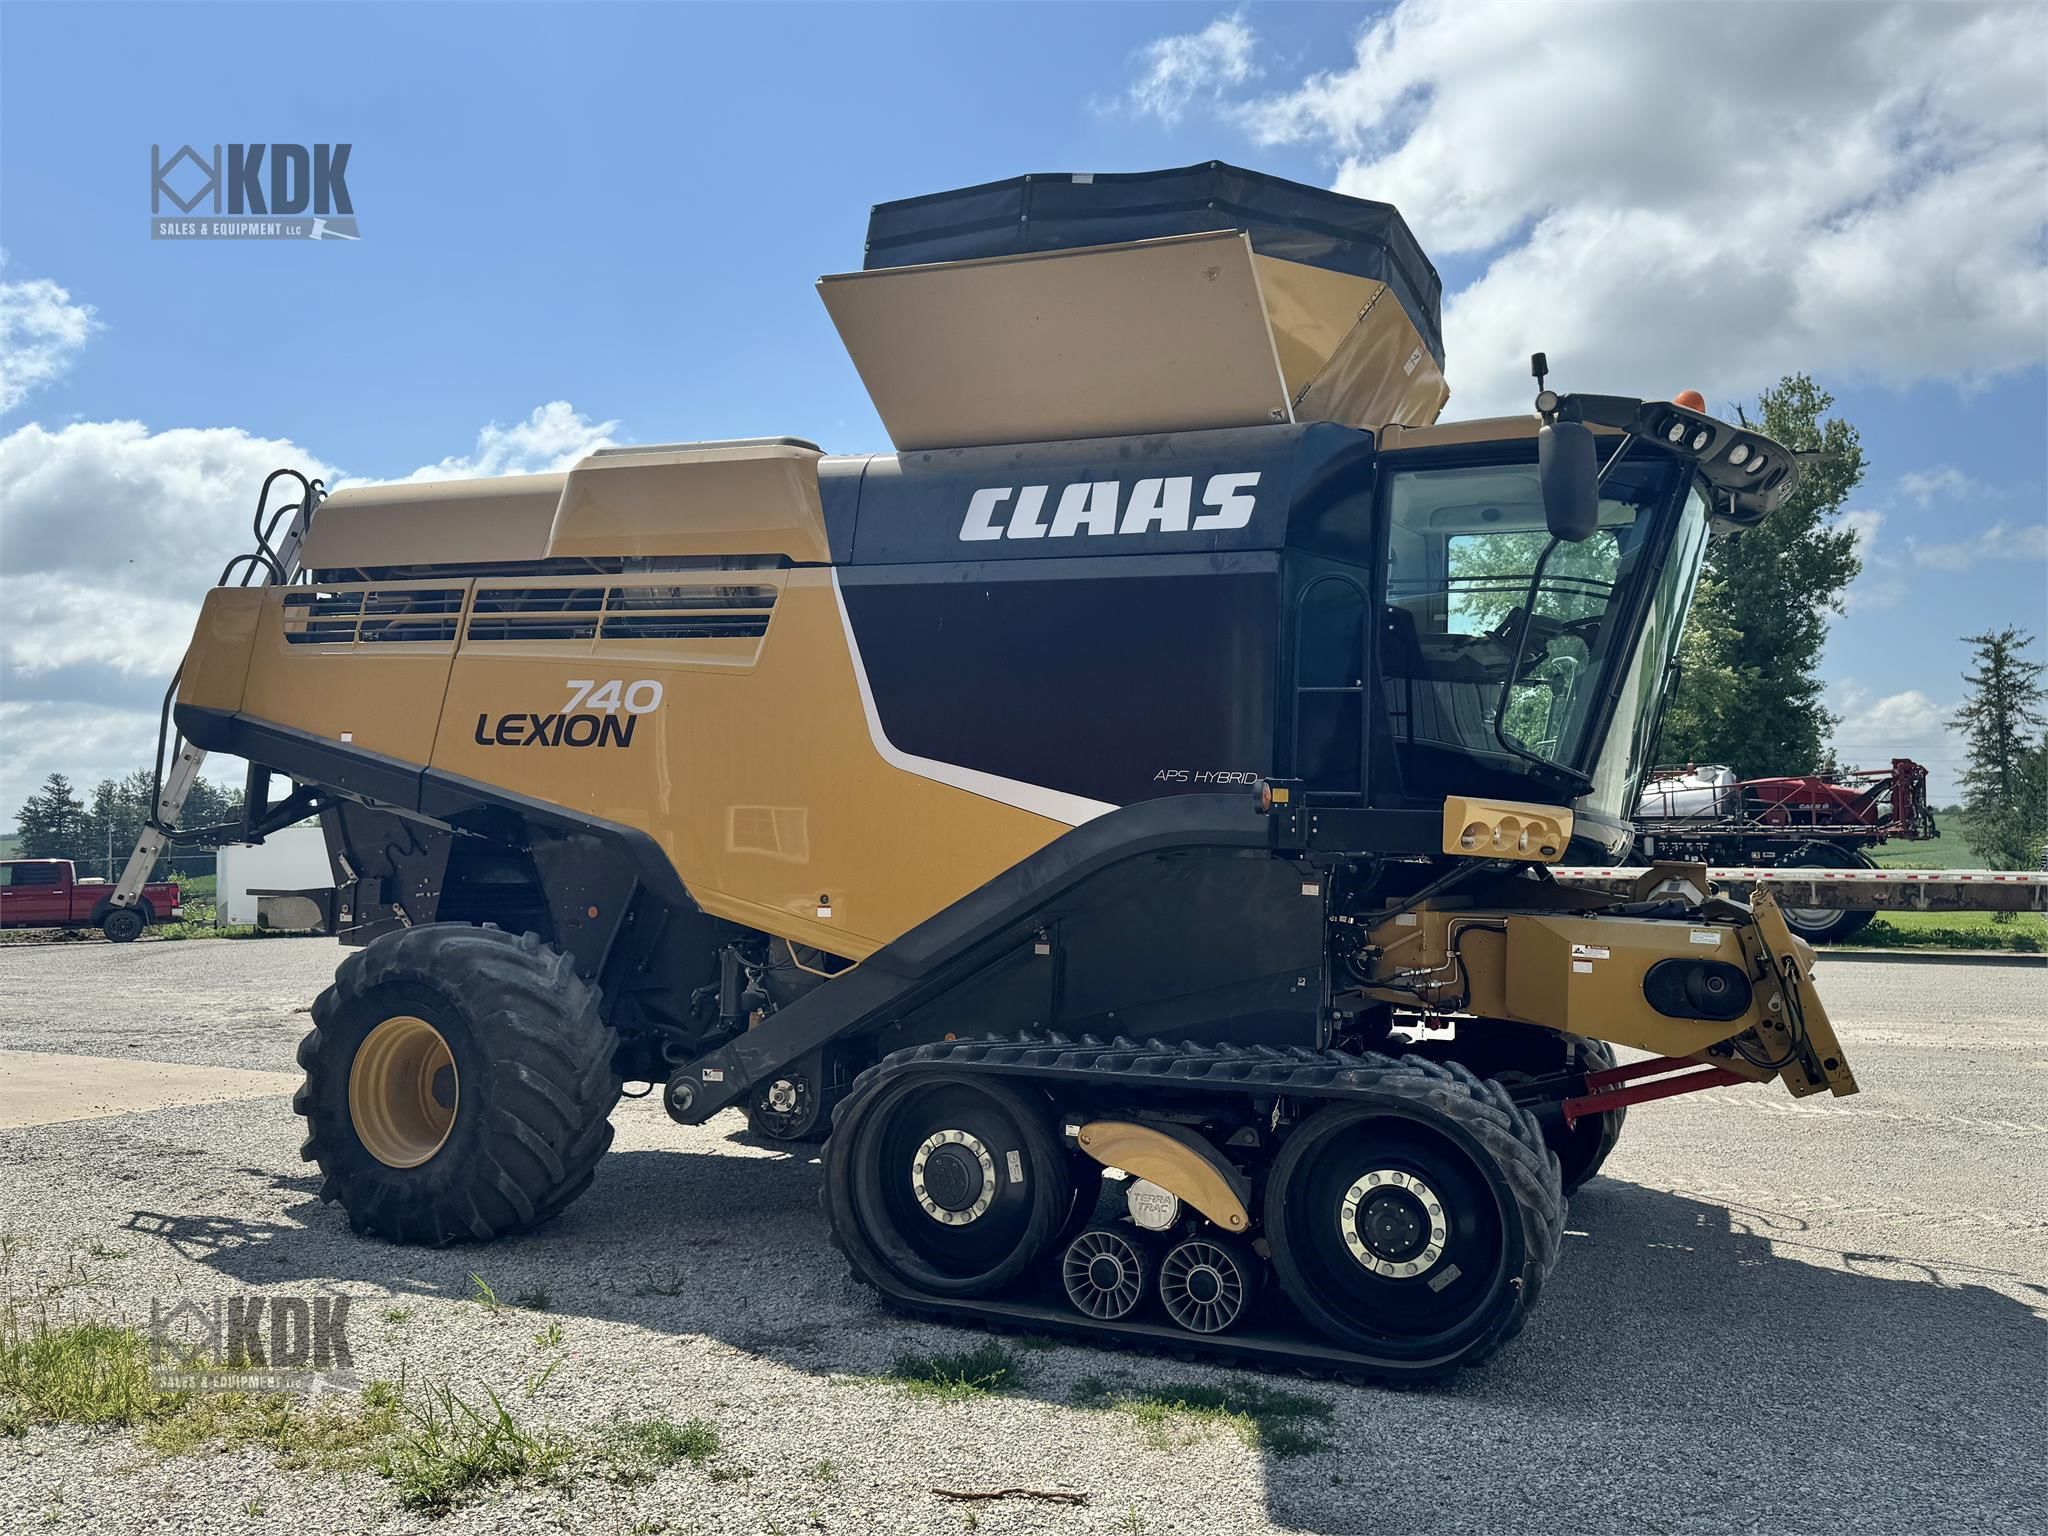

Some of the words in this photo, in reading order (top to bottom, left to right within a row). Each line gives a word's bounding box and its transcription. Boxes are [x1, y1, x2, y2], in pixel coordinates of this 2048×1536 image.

[959, 472, 1261, 541] CLAAS
[560, 679, 664, 714] 740
[475, 713, 637, 747] LEXION
[1154, 769, 1190, 782] APS
[1194, 771, 1258, 785] HYBRID
[1134, 1193, 1171, 1205] TERRA
[1138, 1202, 1168, 1213] TRAC
